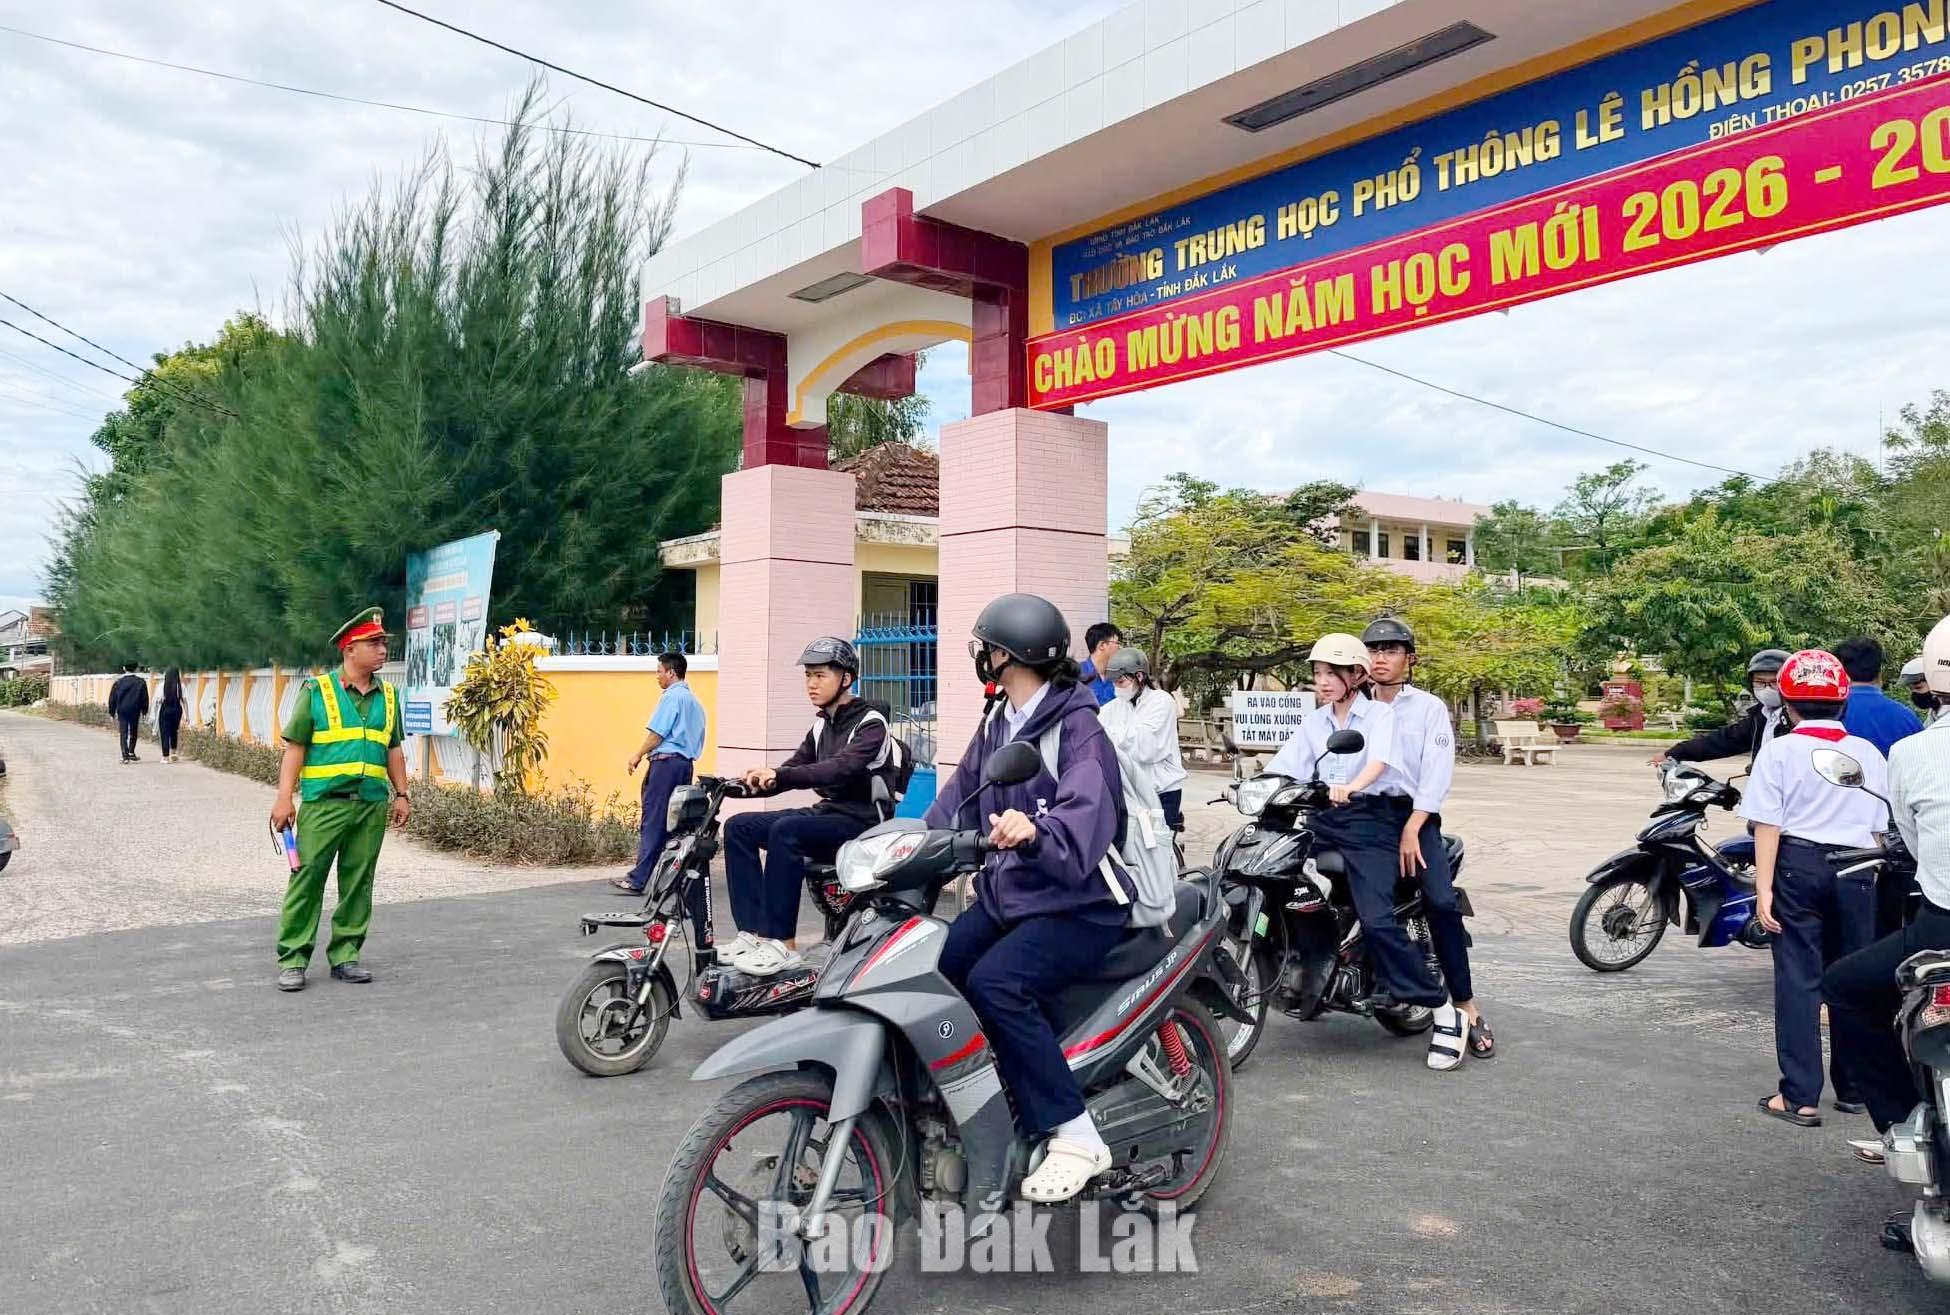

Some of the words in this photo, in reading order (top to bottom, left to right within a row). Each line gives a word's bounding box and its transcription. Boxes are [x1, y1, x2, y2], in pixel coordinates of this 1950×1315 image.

[1840, 73, 1892, 101] 0257
[1070, 247, 1164, 303] TRƯỜNG
[1175, 215, 1265, 272] TRUNG
[1277, 190, 1340, 241] HỌC
[1353, 146, 1423, 217] PHỔ
[1434, 120, 1561, 191] THÔNG
[1576, 92, 1625, 151] LÊ
[1641, 53, 1772, 131] HỒNG
[1791, 0, 1950, 85] PHON
[1034, 336, 1117, 394] CHÀO
[1127, 305, 1241, 372] MỪNG
[1254, 273, 1357, 343] NĂM
[1371, 242, 1471, 315] HỌC
[1489, 201, 1600, 285] MỚI
[1622, 154, 1789, 252] 2026
[1814, 165, 1842, 184] -
[1184, 270, 1208, 292] ĐẮK
[1212, 263, 1237, 284] LẮK
[1247, 697, 1258, 708] RA
[1234, 713, 1248, 724] VUI
